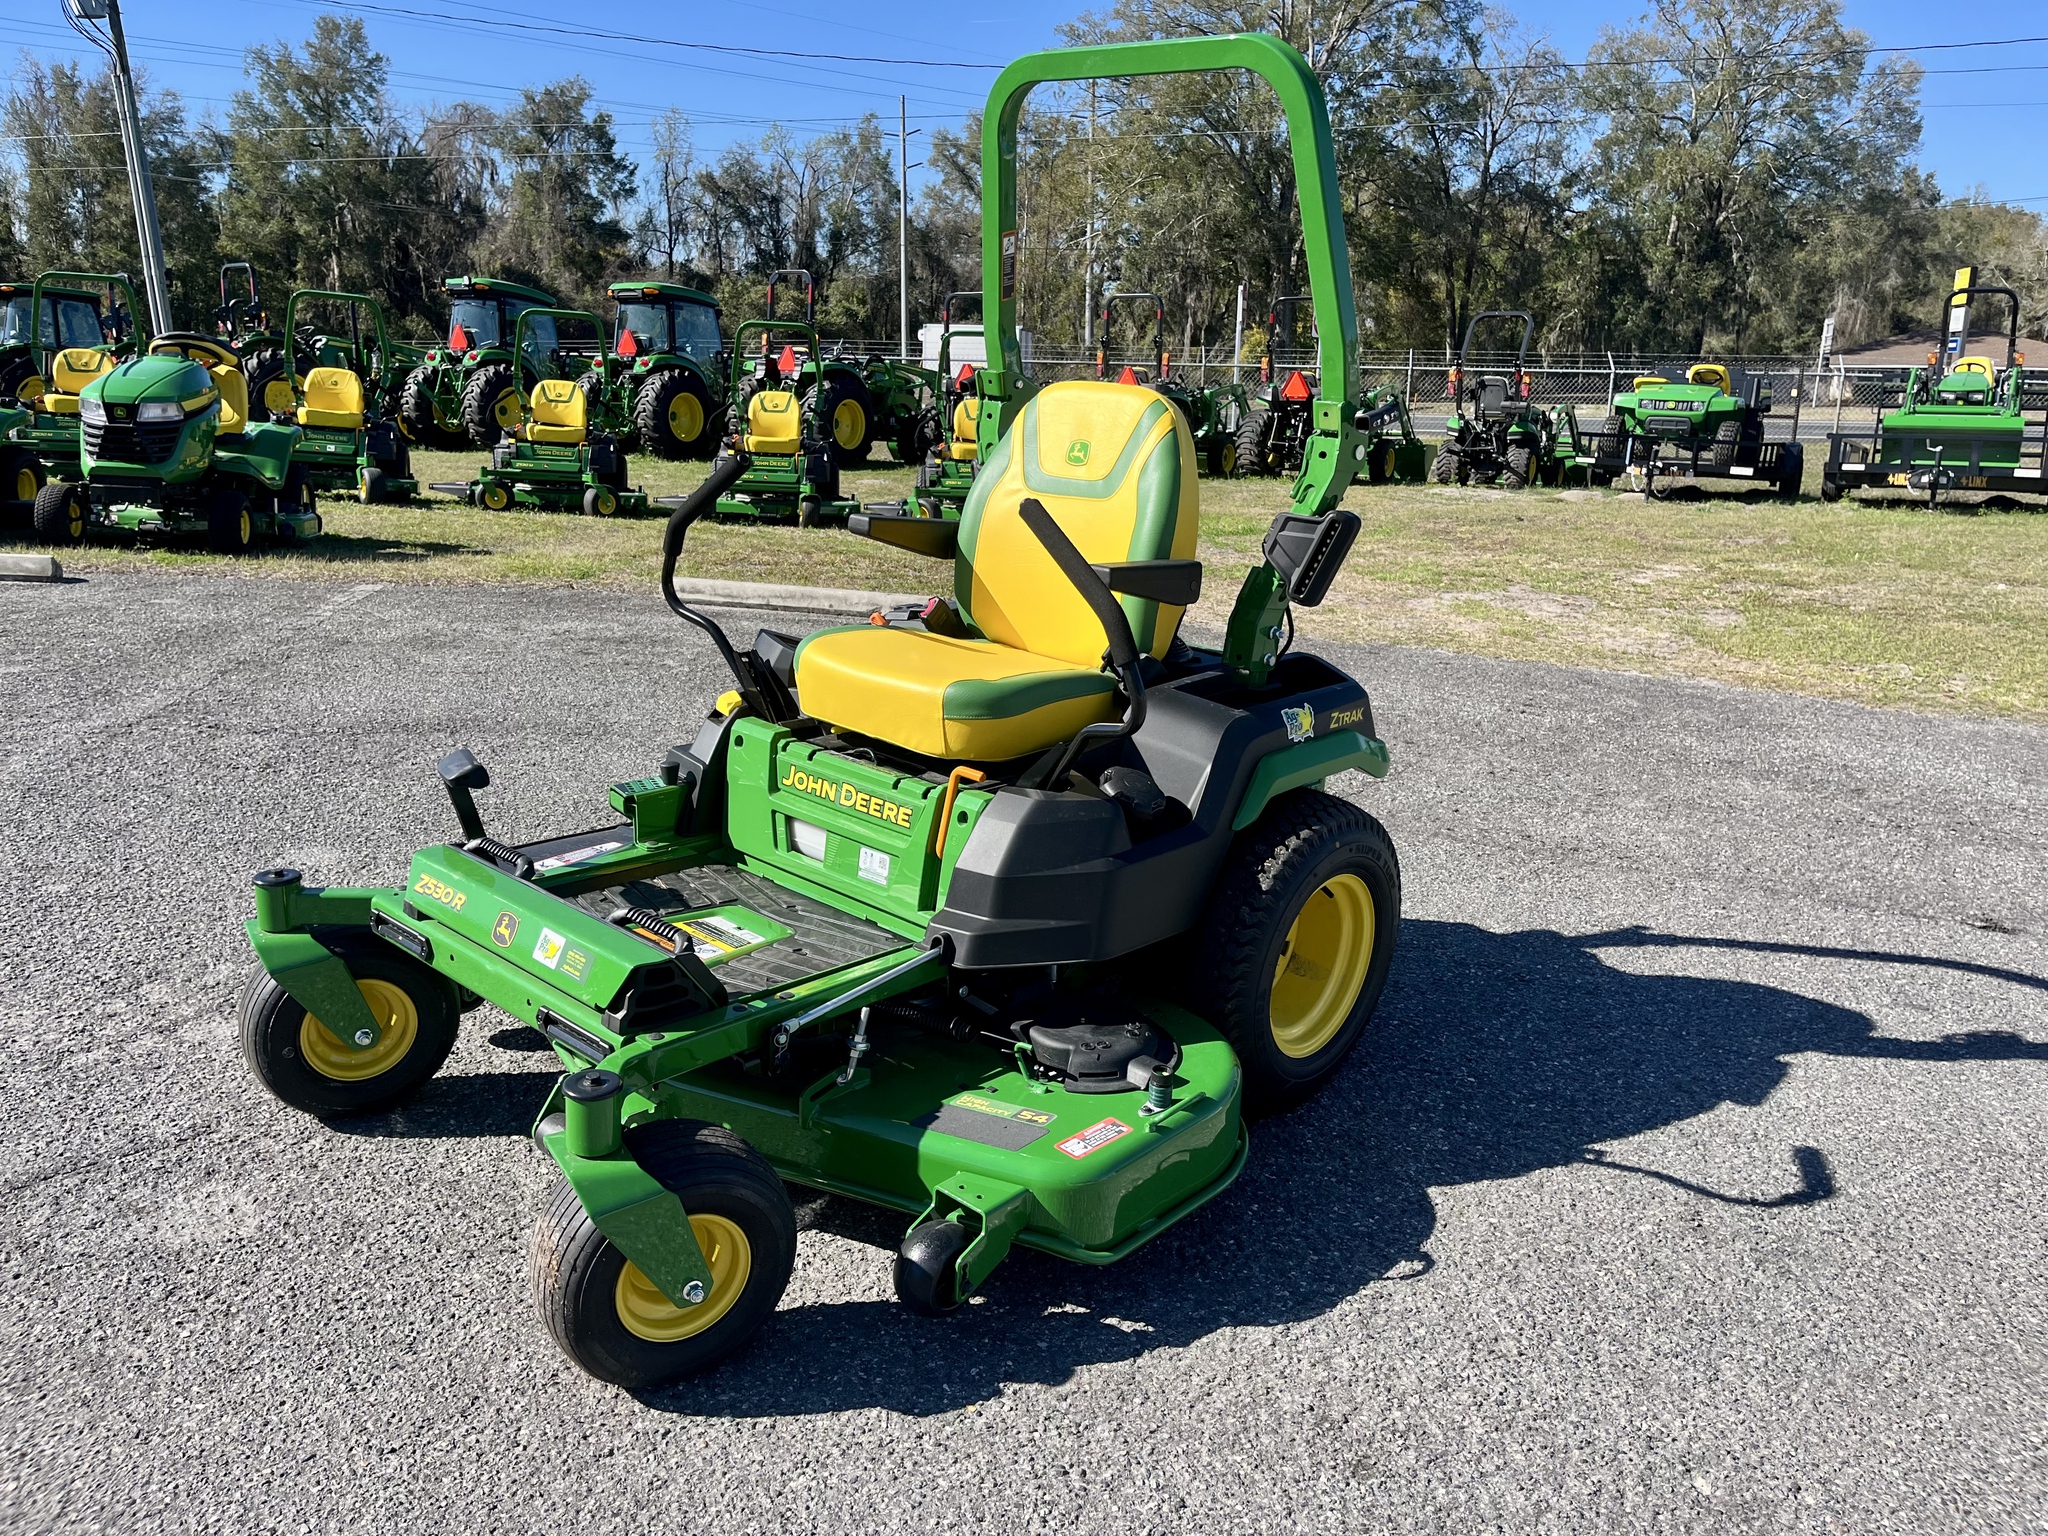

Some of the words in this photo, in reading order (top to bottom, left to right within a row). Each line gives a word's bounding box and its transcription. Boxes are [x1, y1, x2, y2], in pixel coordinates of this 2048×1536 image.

[306, 431, 325, 439] JOHN
[325, 434, 348, 442] DEERE
[1967, 475, 1988, 488] LINX
[1329, 707, 1364, 729] ZTRAK
[782, 765, 837, 802] JOHN
[839, 782, 913, 828] DEERE
[960, 1095, 990, 1106] HIGH
[956, 1100, 1012, 1116] CAPACITY
[1017, 1110, 1049, 1123] 54
